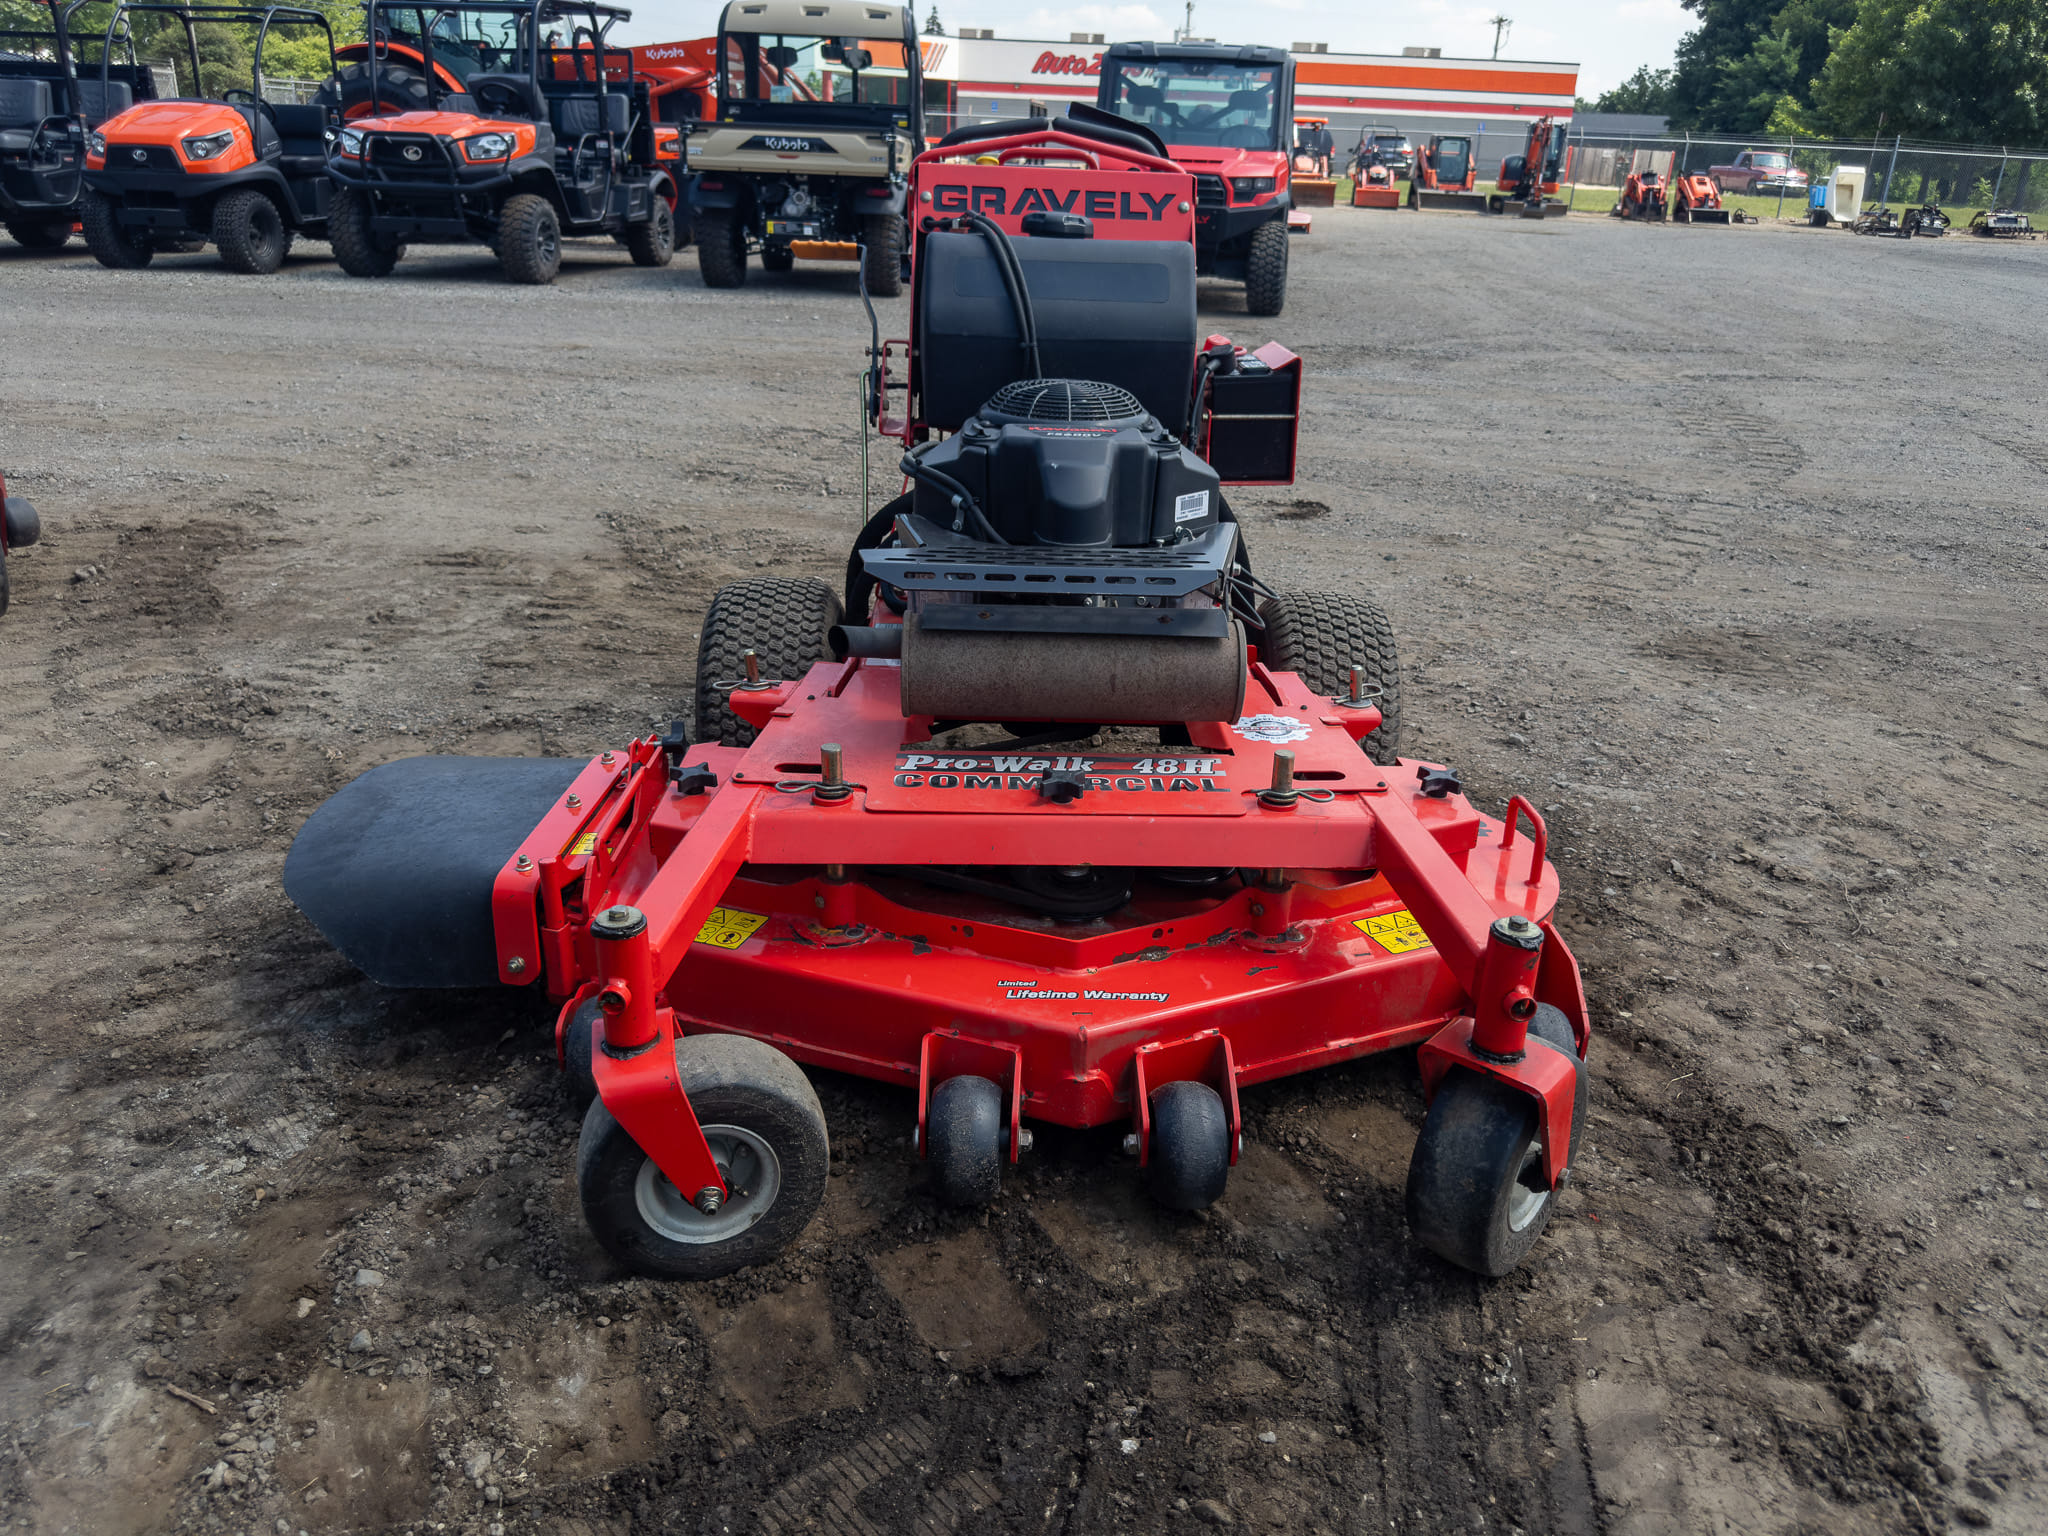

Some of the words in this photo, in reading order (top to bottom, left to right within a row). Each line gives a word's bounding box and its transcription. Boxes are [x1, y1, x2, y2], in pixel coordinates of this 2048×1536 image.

[645, 48, 685, 60] Kubota
[765, 137, 810, 151] Kubota
[933, 184, 1177, 221] GRAVELY
[900, 754, 1095, 773] Pro-Walk
[1132, 758, 1217, 775] 48H
[893, 773, 1232, 793] COMMRCIAL
[997, 980, 1038, 988] Limited
[1006, 989, 1079, 1000] Lifetime
[1082, 990, 1171, 1003] Warranty
